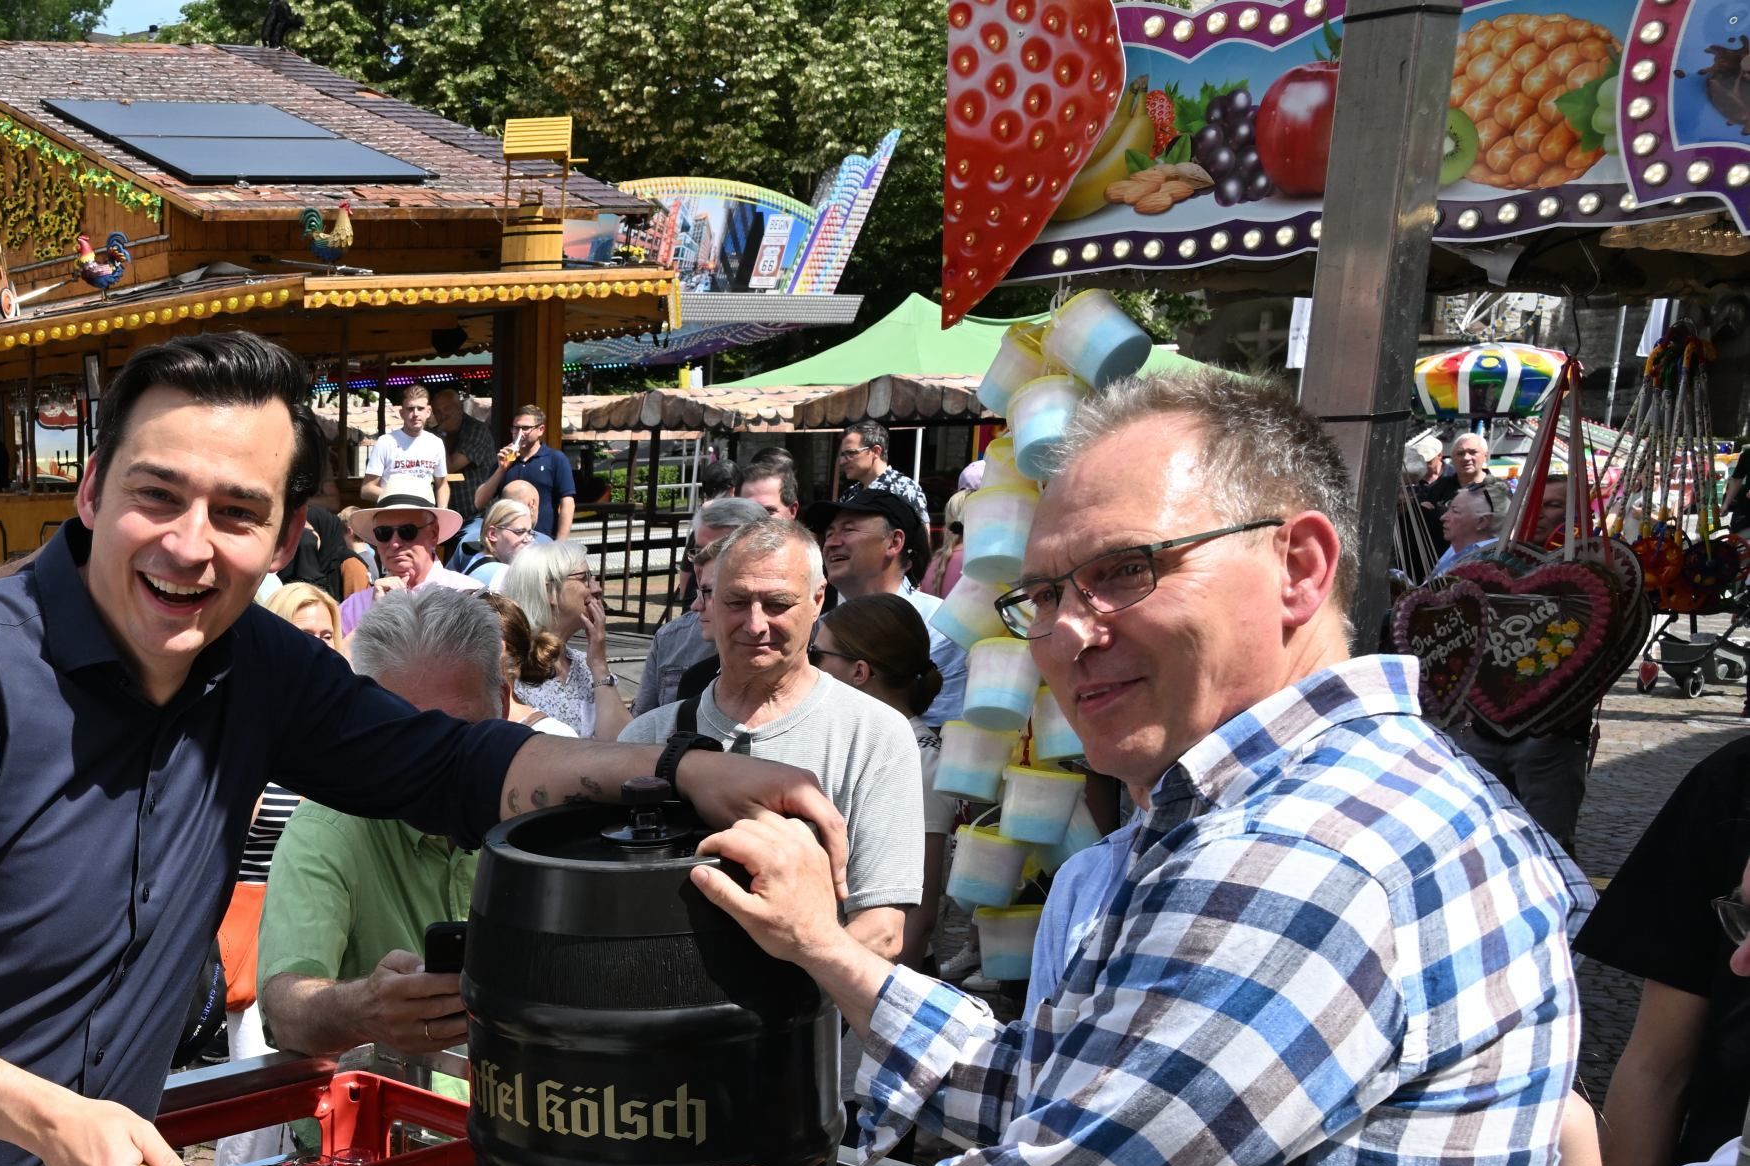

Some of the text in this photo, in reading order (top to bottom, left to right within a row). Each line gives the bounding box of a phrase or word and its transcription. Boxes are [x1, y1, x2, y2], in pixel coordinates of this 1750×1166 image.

[761, 260, 775, 272] 66
[1411, 634, 1436, 656] Du
[1433, 607, 1465, 638] bist
[1499, 599, 1560, 637] Dich
[1491, 632, 1539, 668] lieb
[536, 1079, 707, 1147] Kölsch
